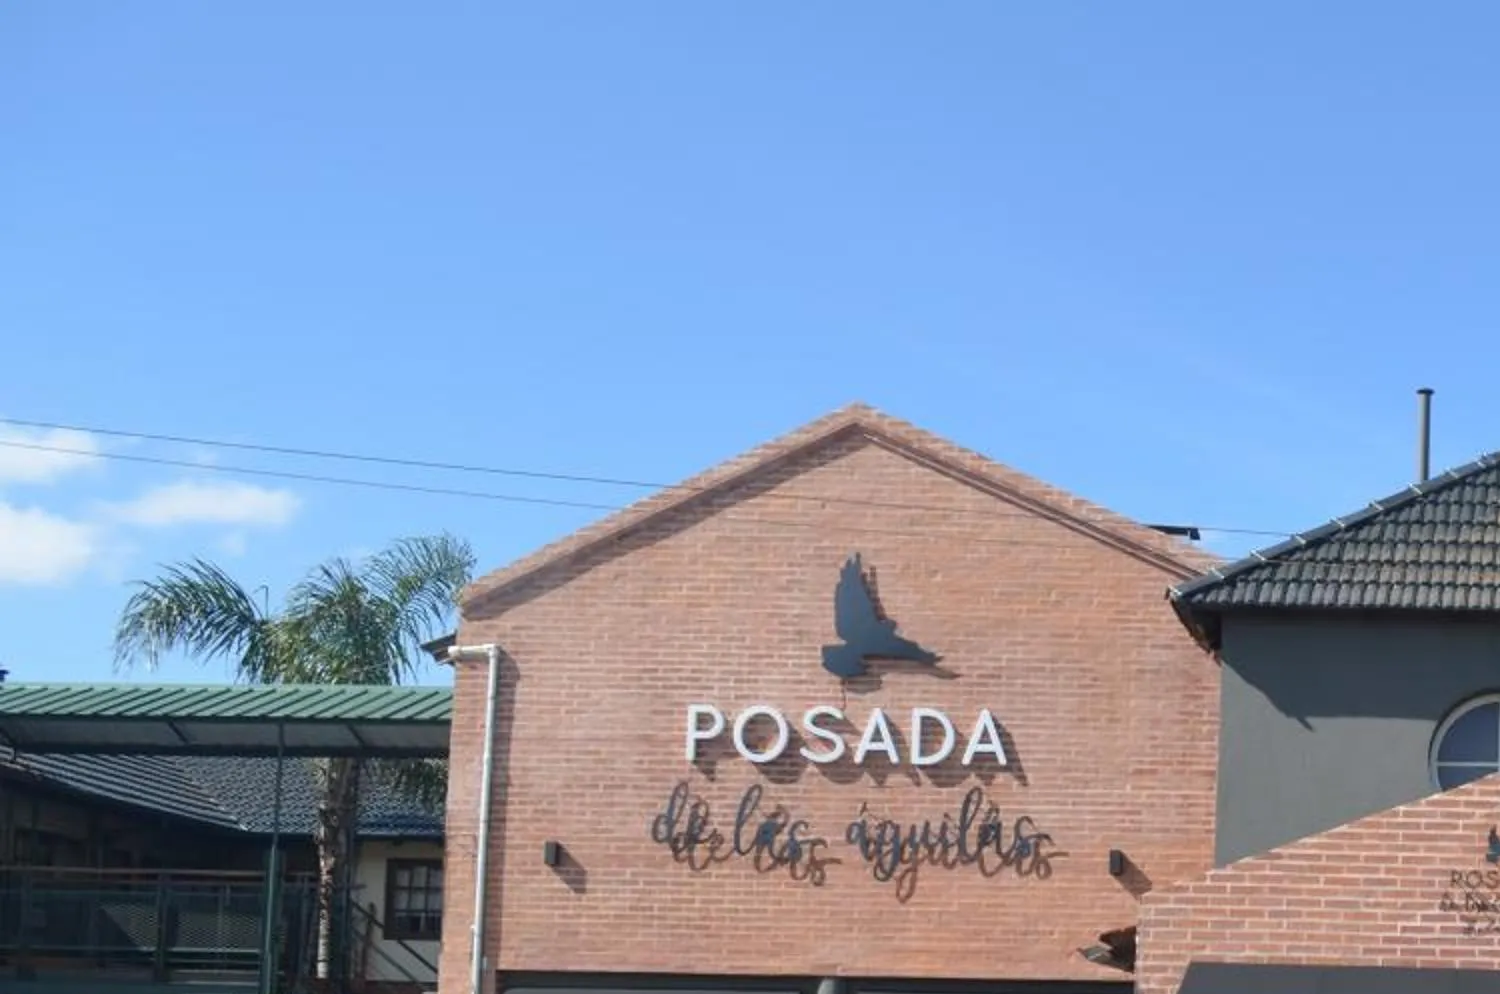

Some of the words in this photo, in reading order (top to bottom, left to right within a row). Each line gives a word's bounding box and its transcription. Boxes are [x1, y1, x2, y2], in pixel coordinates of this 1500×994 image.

[686, 704, 1008, 767] POSADA
[652, 781, 718, 849] de
[734, 784, 828, 867] las
